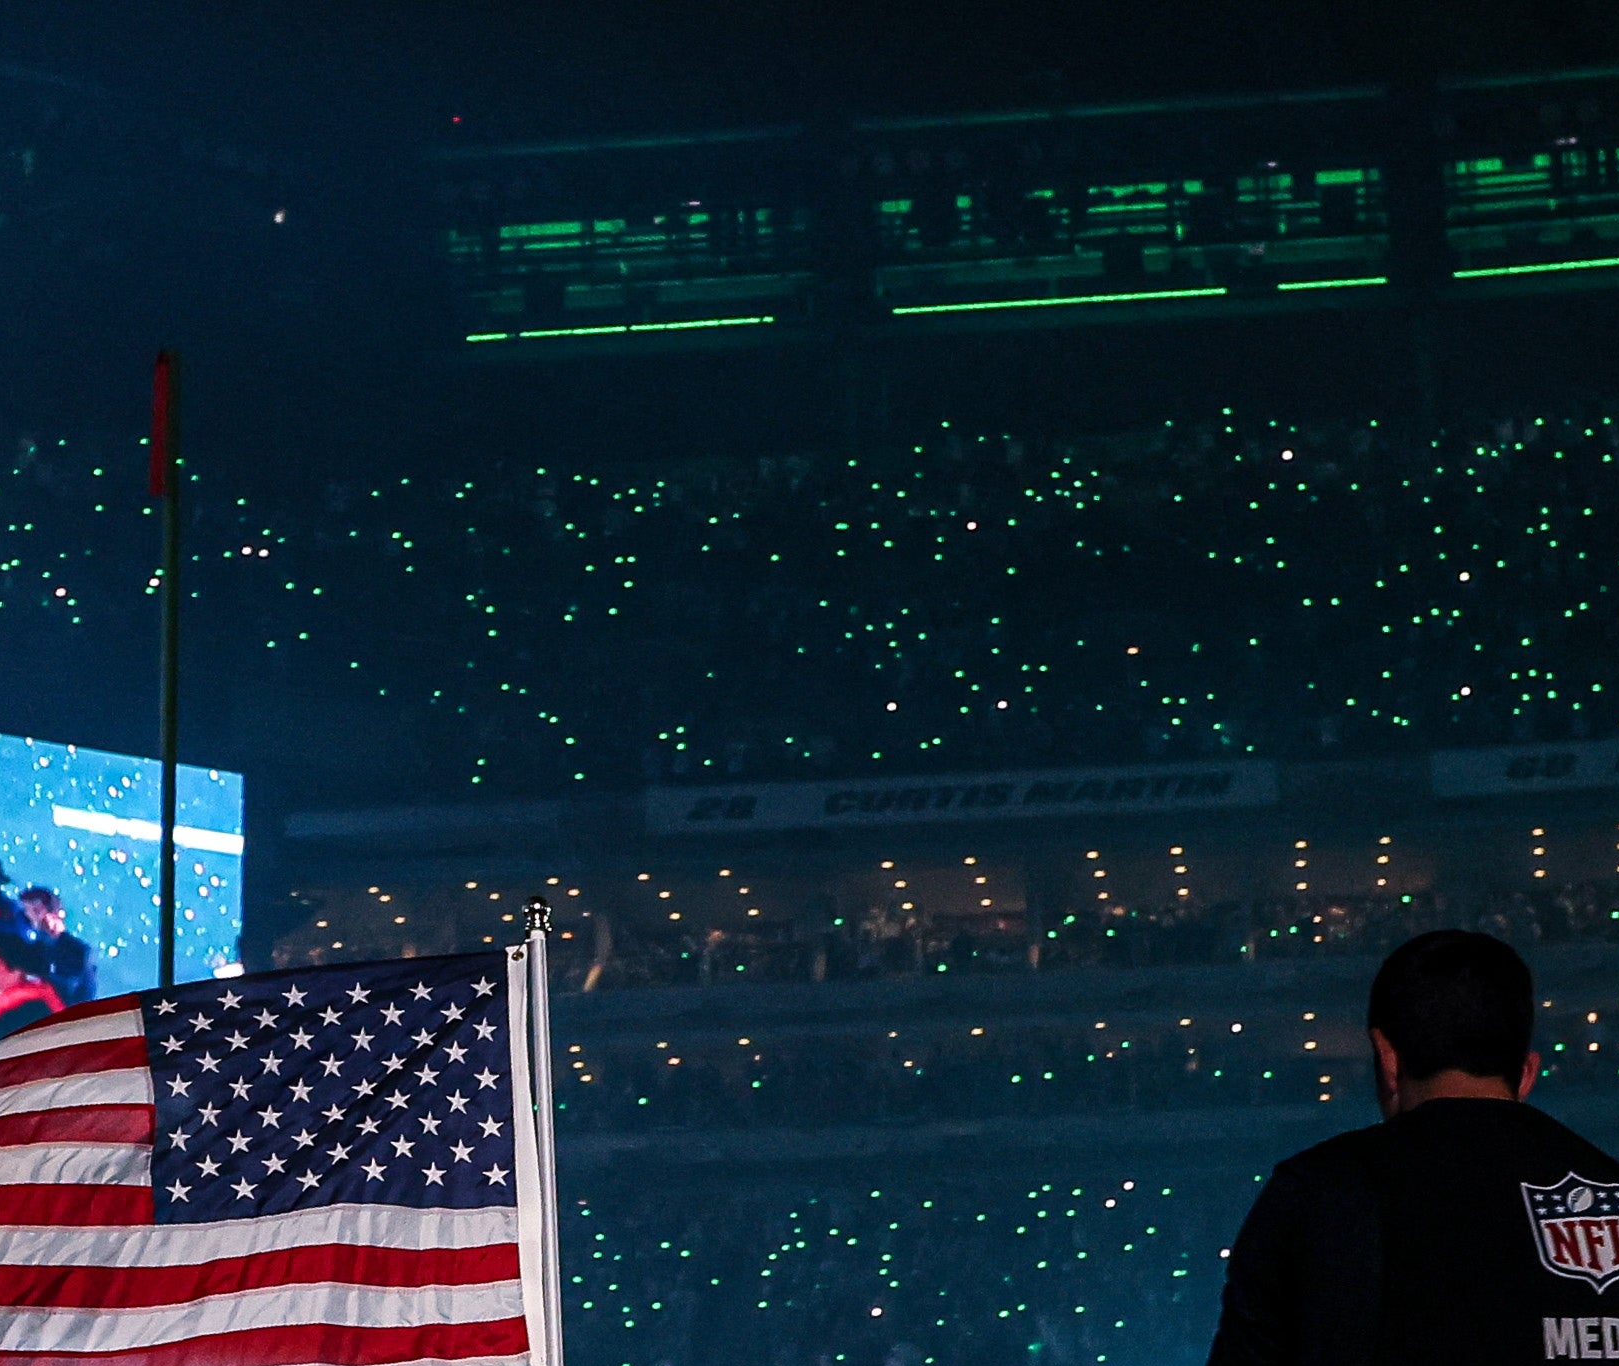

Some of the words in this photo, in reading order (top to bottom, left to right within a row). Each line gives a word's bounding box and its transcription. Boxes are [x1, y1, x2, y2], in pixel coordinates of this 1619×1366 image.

[685, 795, 758, 821] 28
[823, 782, 1015, 816] CURTIS
[1023, 771, 1235, 804] MARTIN
